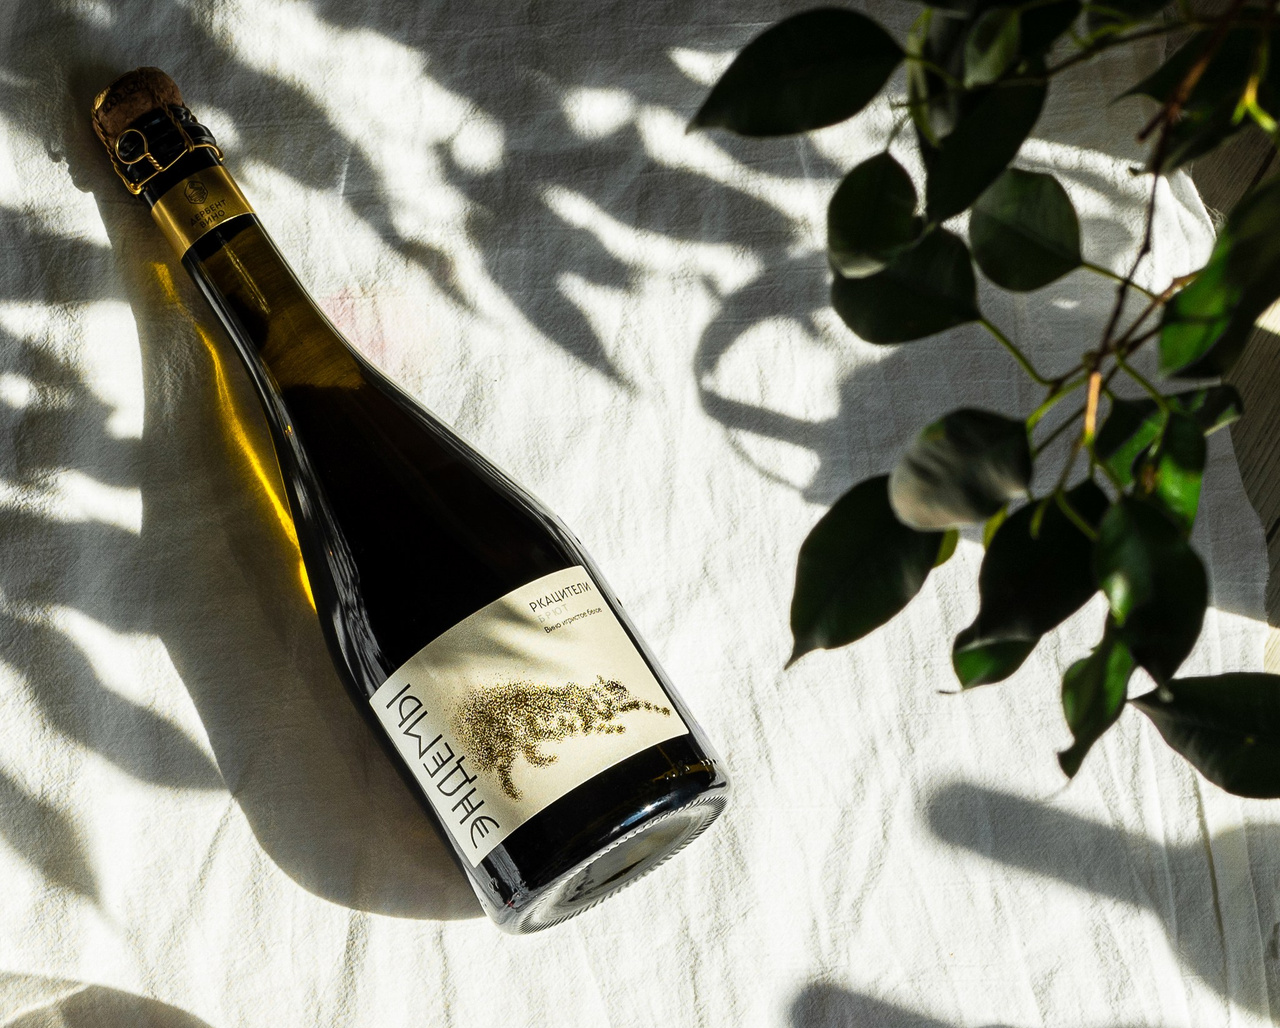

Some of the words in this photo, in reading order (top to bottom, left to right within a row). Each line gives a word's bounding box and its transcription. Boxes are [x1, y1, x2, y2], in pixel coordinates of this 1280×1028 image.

[190, 199, 227, 227] ДЕРБЕНТ
[200, 210, 225, 229] ВИНО
[528, 581, 592, 612] РКАЦИТЕЛИ
[538, 604, 569, 623] БРЮТ
[543, 622, 562, 634] Вино
[386, 683, 500, 849] ЭНДЕМЫ
